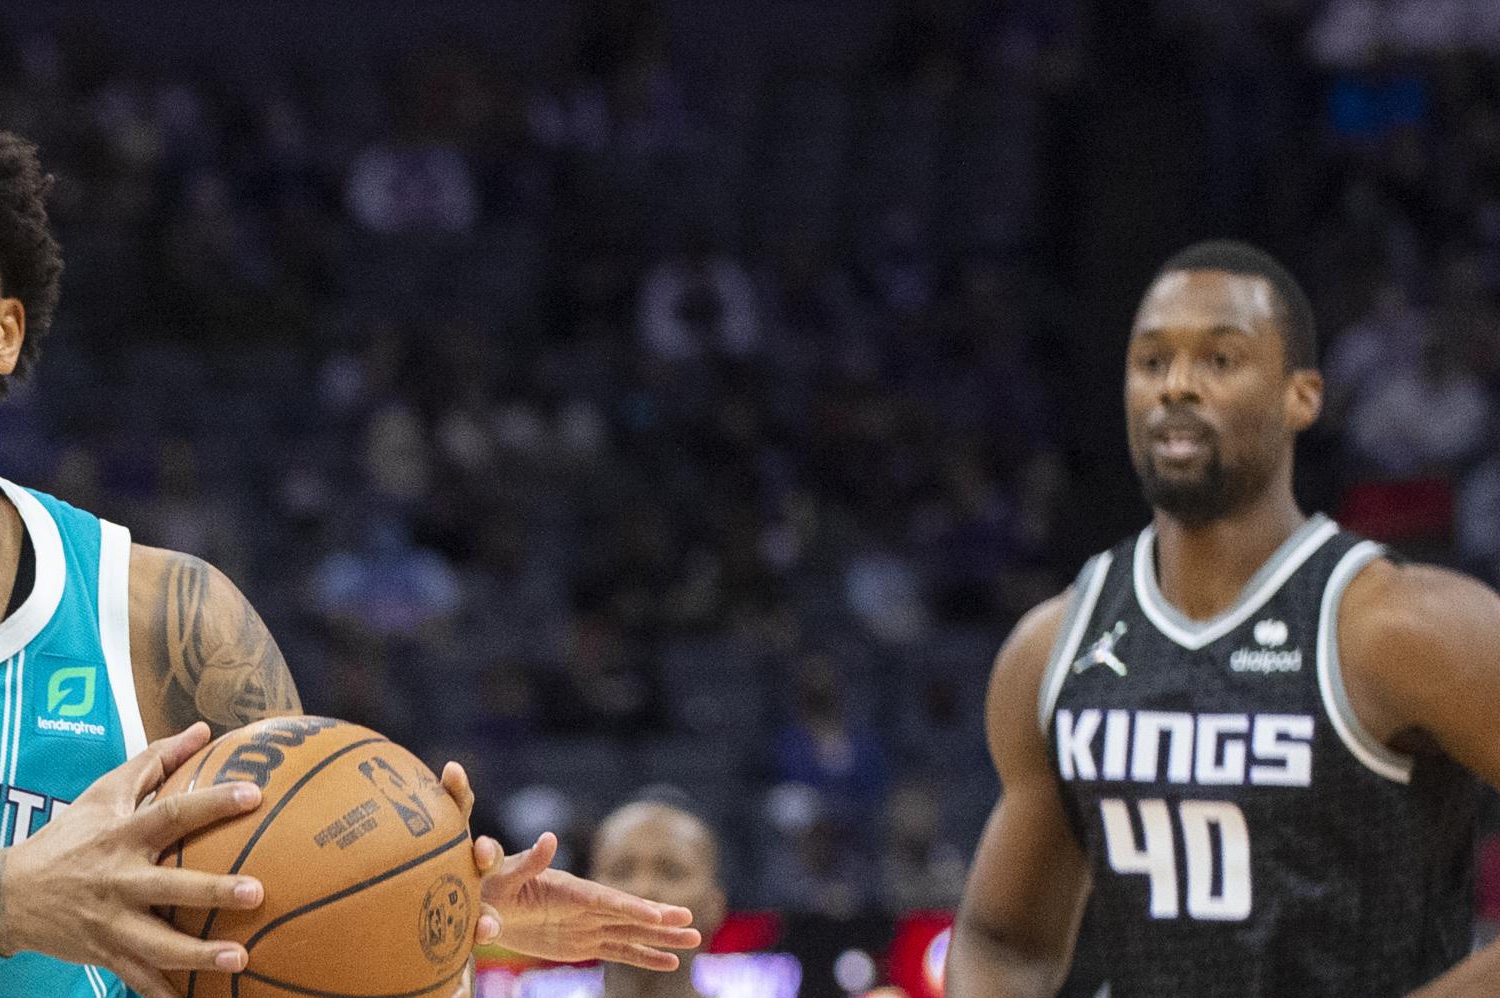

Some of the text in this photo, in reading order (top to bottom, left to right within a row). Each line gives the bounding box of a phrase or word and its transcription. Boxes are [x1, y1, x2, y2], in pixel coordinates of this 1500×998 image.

[37, 715, 105, 736] lendingtree
[1055, 708, 1315, 788] KINGS
[1100, 798, 1252, 921] 40
